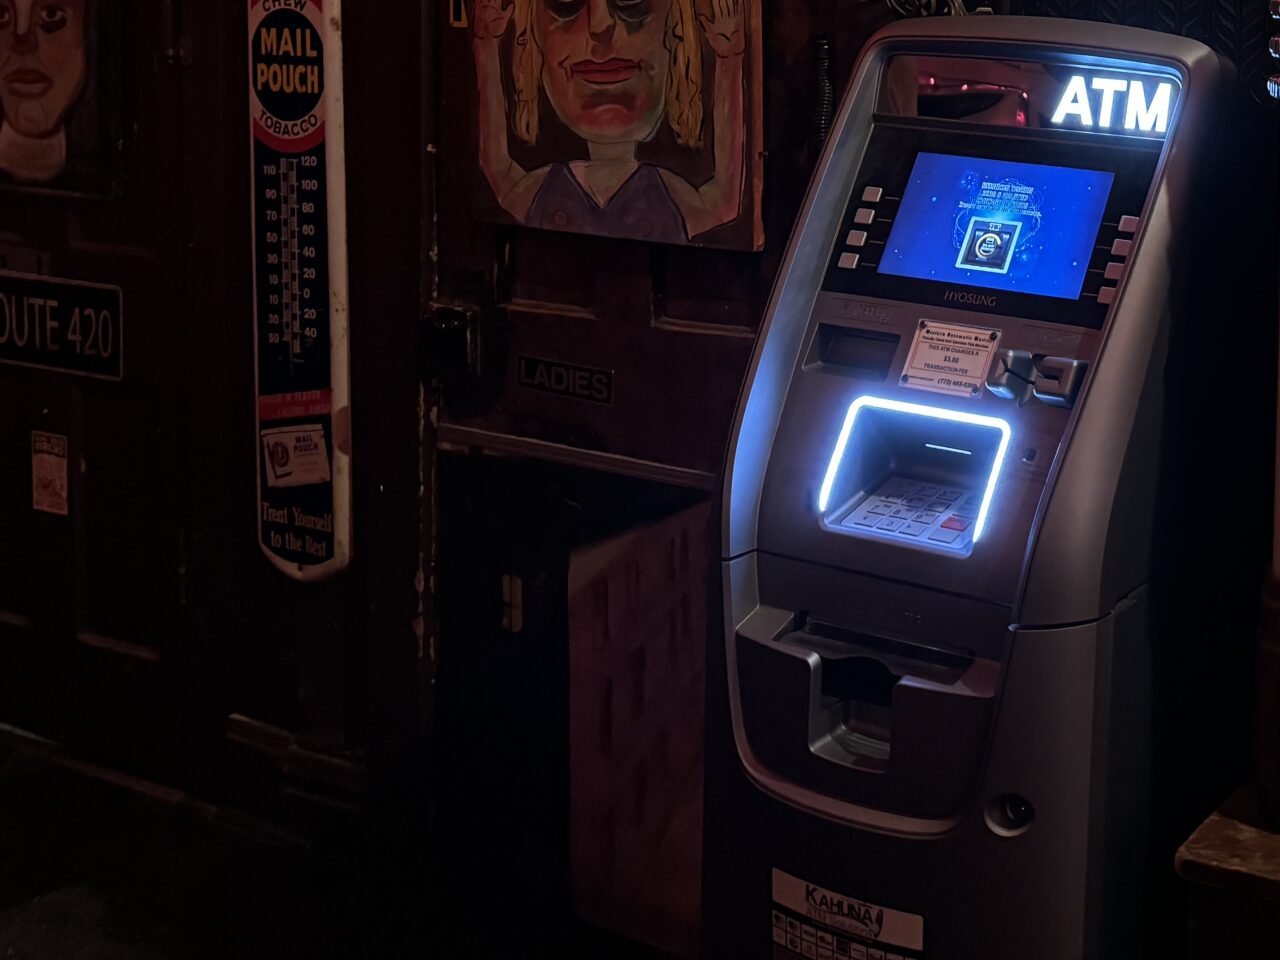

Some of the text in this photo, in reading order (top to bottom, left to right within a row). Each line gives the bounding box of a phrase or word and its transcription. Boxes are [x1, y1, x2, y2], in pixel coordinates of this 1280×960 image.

[260, 27, 318, 57] MAIL
[256, 63, 319, 94] POUCH
[1051, 76, 1172, 132] ATM
[259, 109, 318, 137] TOBACCO
[301, 156, 317, 167] 120
[263, 165, 276, 175] 110
[301, 180, 317, 191] 100
[302, 202, 314, 213] 80
[266, 211, 277, 221] 70
[302, 224, 314, 235] 60
[267, 232, 278, 243] 50
[303, 247, 315, 258] 40
[267, 254, 278, 264] 30
[303, 268, 315, 279] 20
[269, 275, 278, 285] 10
[269, 294, 279, 304] 10
[304, 289, 310, 299] 0
[944, 290, 997, 307] HYOSUNG
[268, 314, 279, 324] 30
[304, 309, 316, 320] 20
[67, 306, 112, 358] 420
[305, 327, 317, 338] 40
[943, 355, 960, 364] $3.00
[924, 363, 958, 373] TRANSACTION
[520, 360, 608, 399] LADIES
[295, 434, 313, 443] MAIL
[294, 443, 319, 453] POUCH
[262, 501, 332, 533] Treat Yourself
[271, 530, 327, 559] to the Best
[805, 884, 873, 924] KAHUNA
